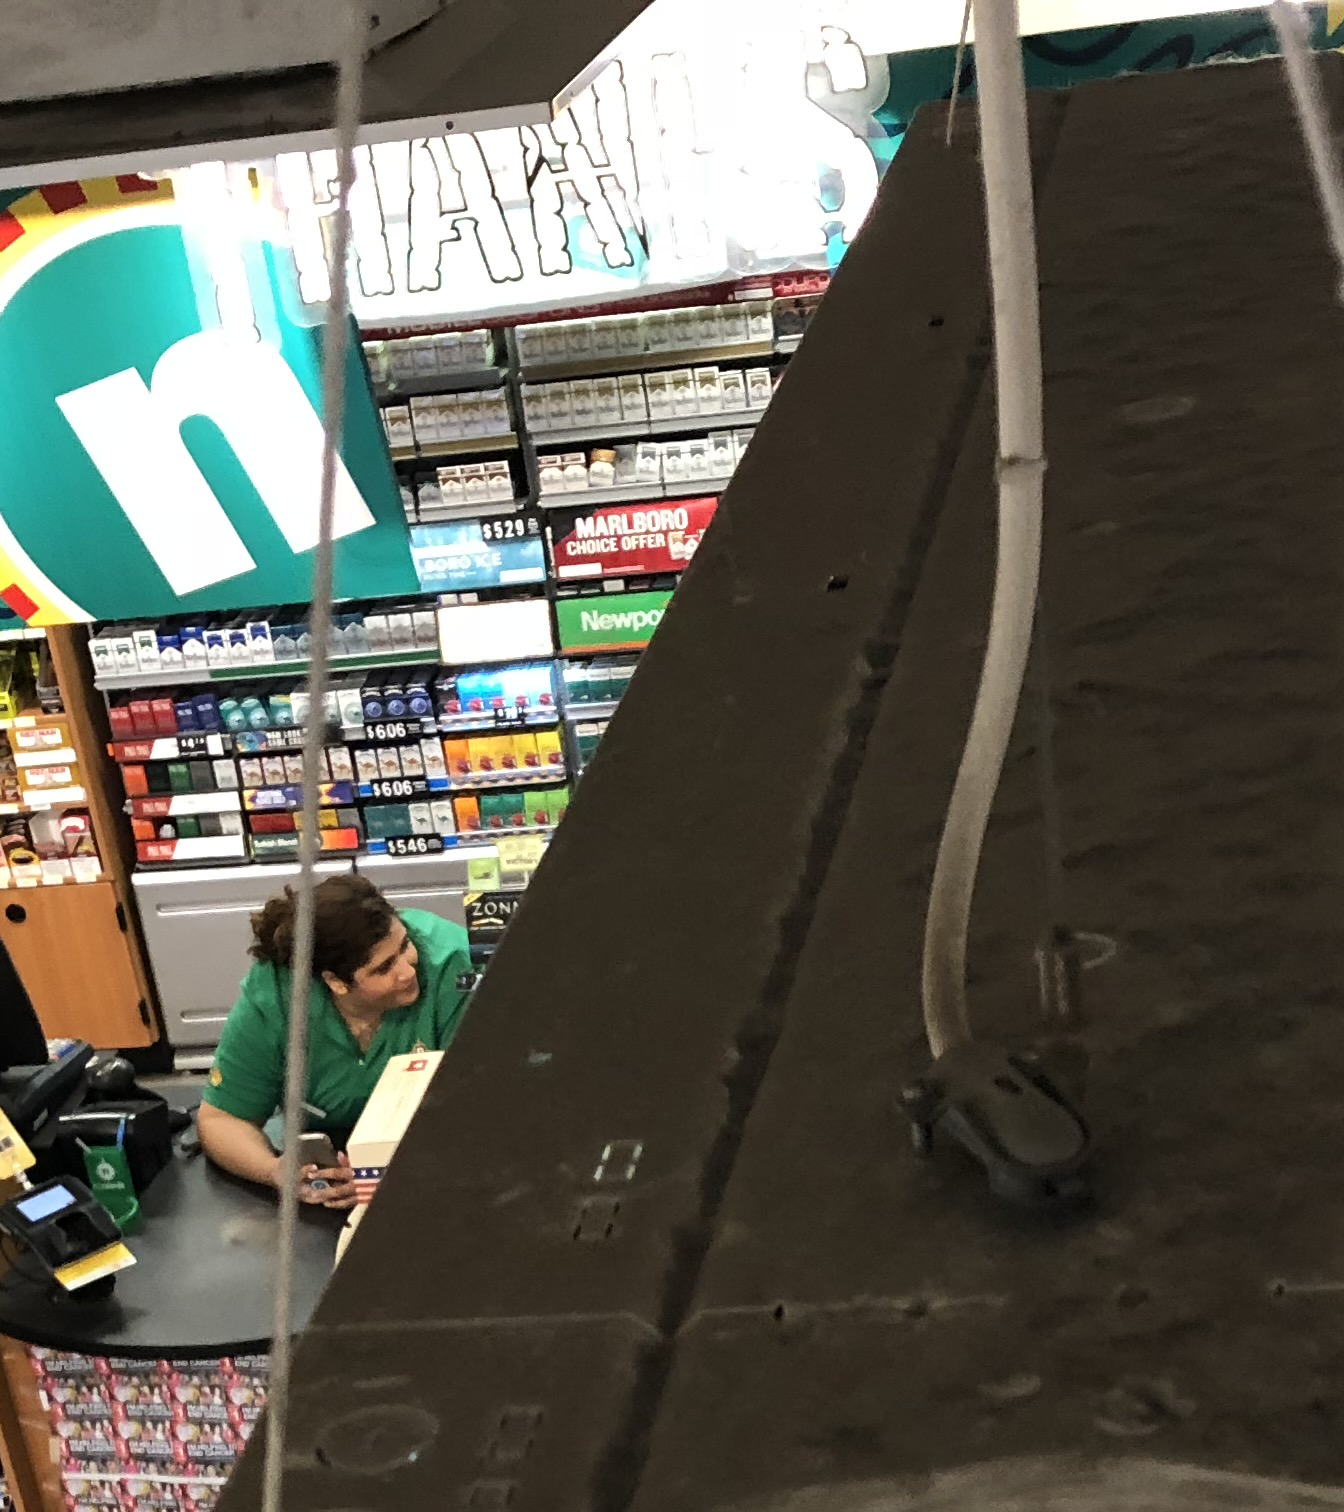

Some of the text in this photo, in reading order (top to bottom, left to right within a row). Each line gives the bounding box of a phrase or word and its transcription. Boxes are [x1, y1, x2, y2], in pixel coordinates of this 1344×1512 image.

[575, 508, 688, 539] MARLBORO
[567, 533, 665, 555] CHOICE OFFER
[581, 608, 664, 632] Newpo
